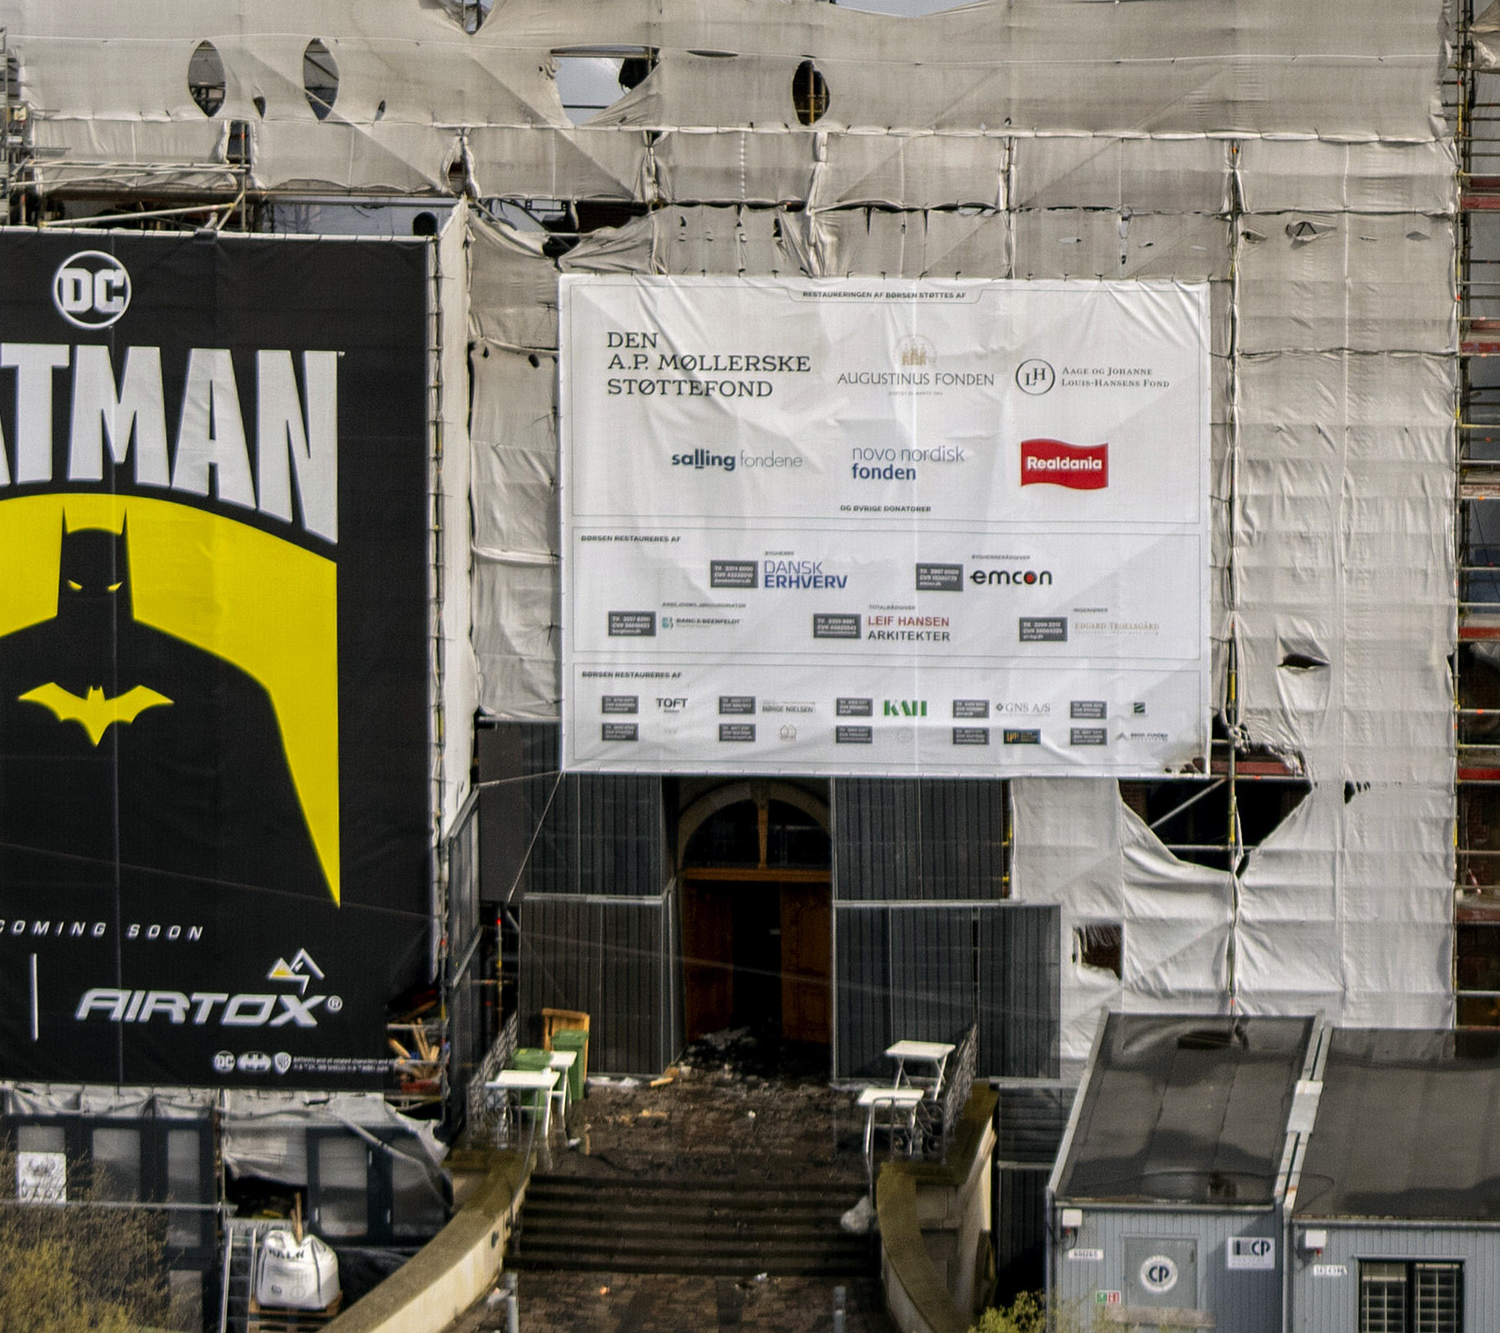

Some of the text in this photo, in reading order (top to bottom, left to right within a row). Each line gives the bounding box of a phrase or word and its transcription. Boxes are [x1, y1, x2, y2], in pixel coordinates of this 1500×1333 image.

[60, 266, 126, 314] DC
[607, 332, 659, 348] DEN
[607, 354, 811, 372] A.P. MØLLERSKE
[837, 372, 995, 386] AUGUSTINUS FONDEN
[607, 379, 773, 397] STØTTEFOND
[671, 448, 803, 472] salling fondene
[852, 445, 965, 463] novo nordisk
[1027, 455, 1102, 470] Realdania
[851, 462, 916, 480] fonden
[764, 560, 823, 575] DANSK
[764, 575, 848, 589] ERHVERV
[969, 569, 1053, 585] emcon
[868, 615, 950, 627] LEIF HANSEN
[867, 630, 951, 642] ARKITEKTER
[655, 697, 689, 708] TOFT
[1005, 703, 1051, 713] GNS A/S
[126, 923, 204, 941] SOON
[75, 987, 327, 1028] AIRTOX
[215, 1054, 235, 1066] DC
[1251, 1240, 1270, 1256] CP
[1148, 1264, 1170, 1283] CP
